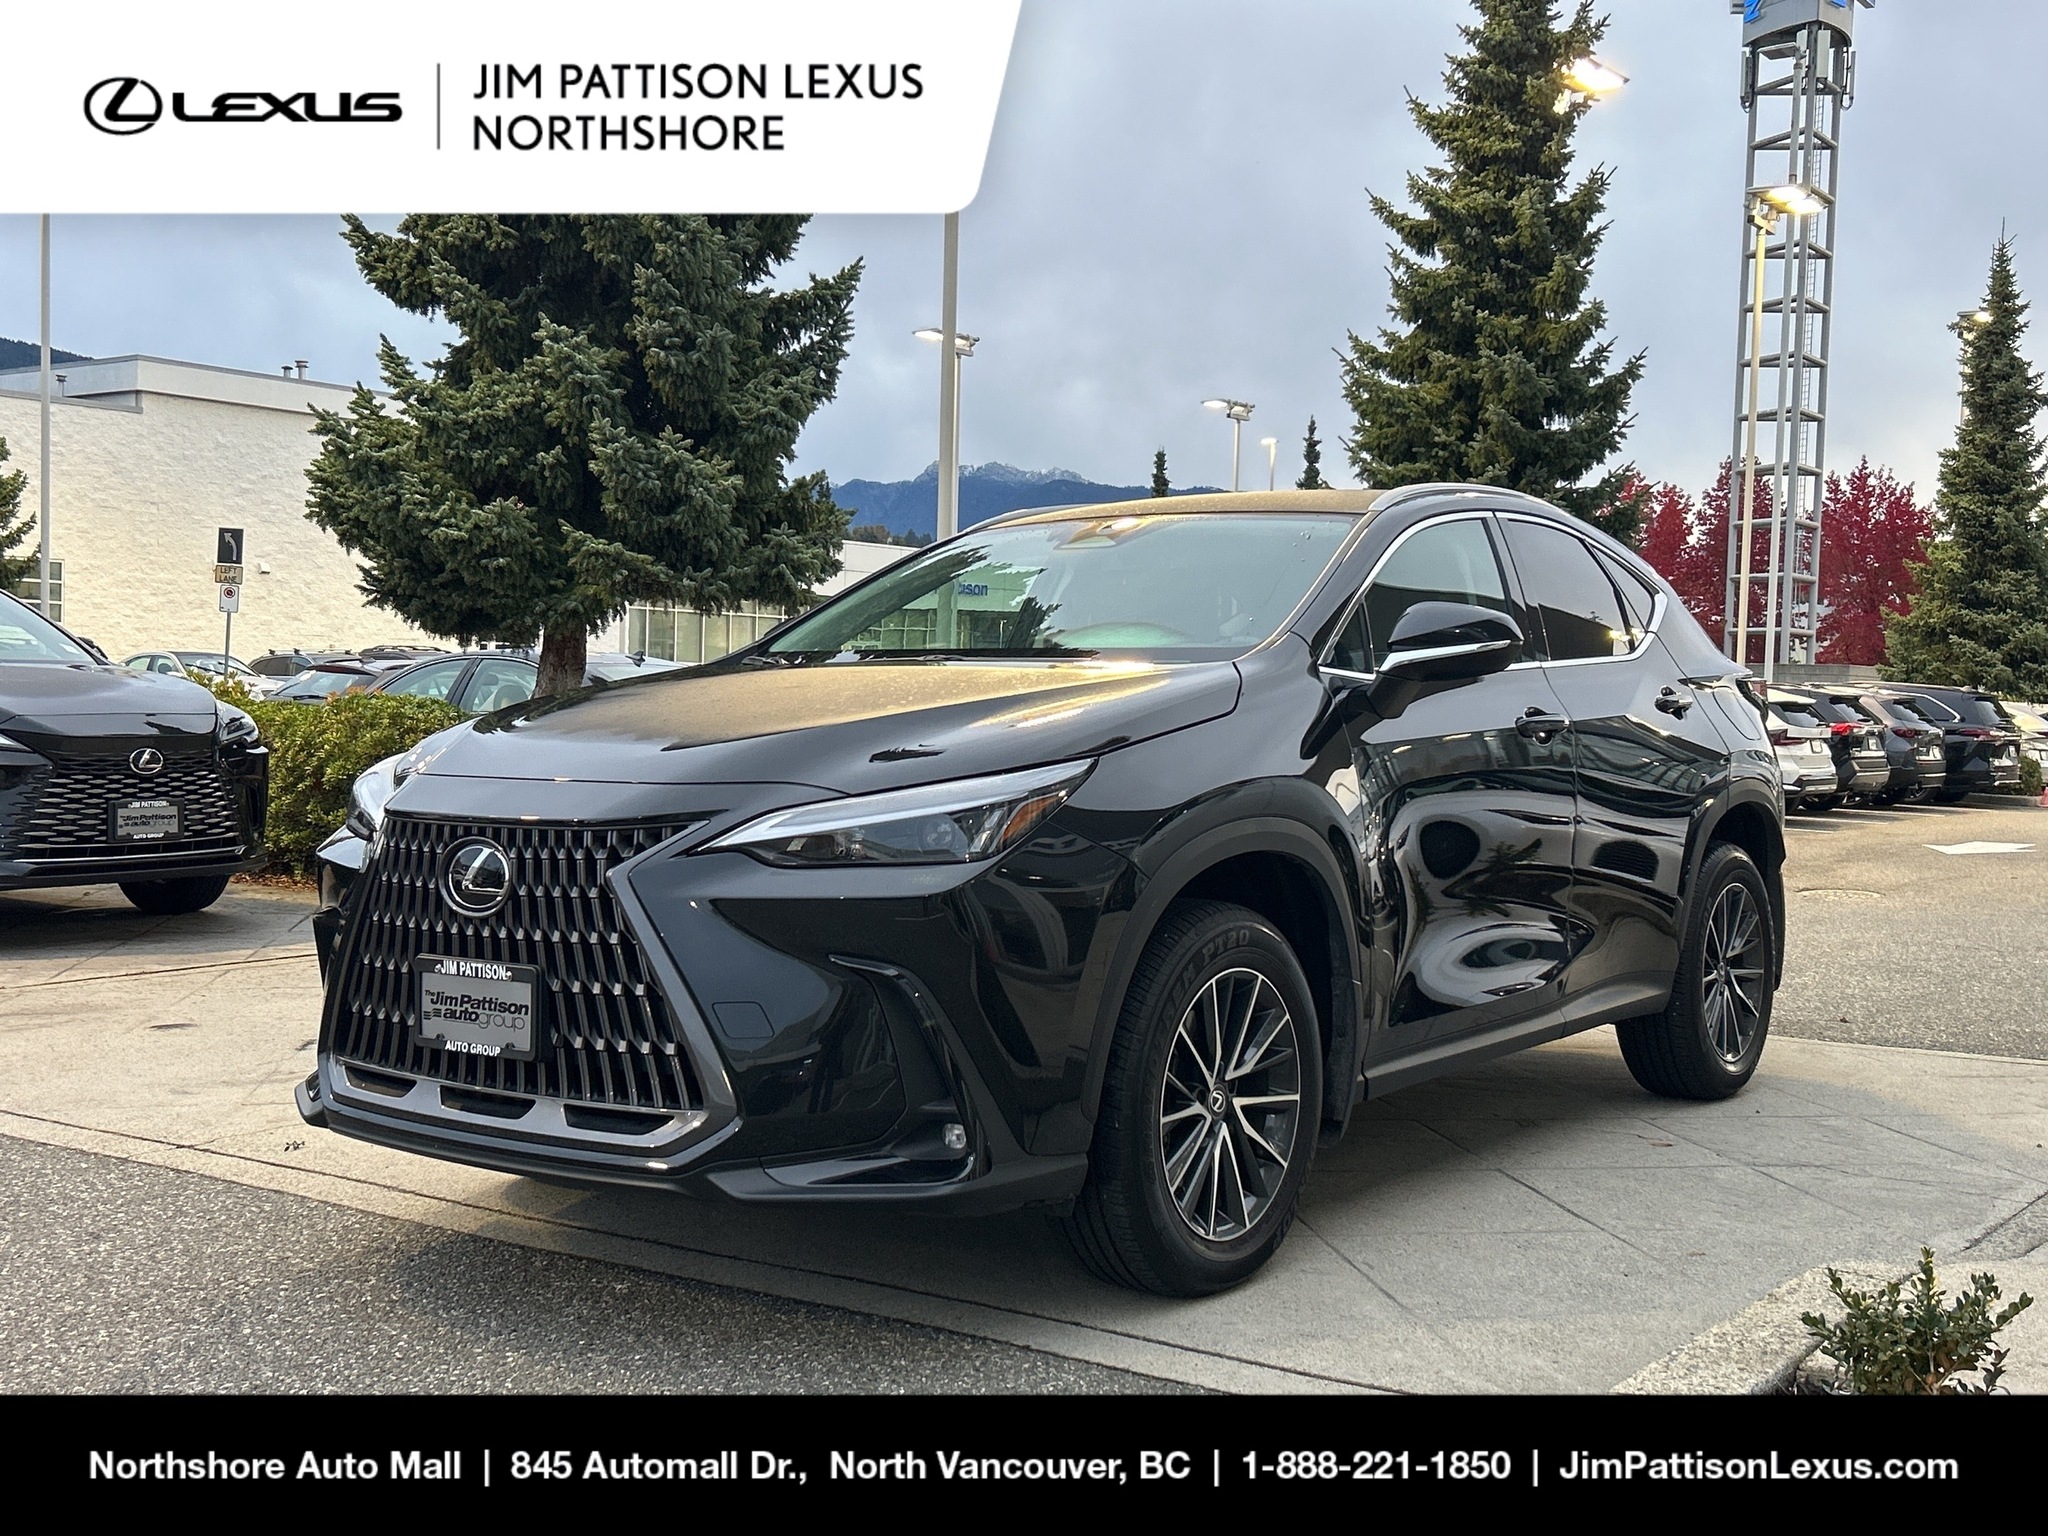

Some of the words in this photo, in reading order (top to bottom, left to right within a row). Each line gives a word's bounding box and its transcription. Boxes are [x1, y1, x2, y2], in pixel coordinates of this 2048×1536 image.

[1201, 929, 1250, 967] PT20
[441, 959, 458, 975] JIM
[460, 962, 507, 980] PATTISON
[424, 989, 436, 997] The
[445, 1040, 469, 1052] AUTO
[470, 1043, 501, 1057] GROUP
